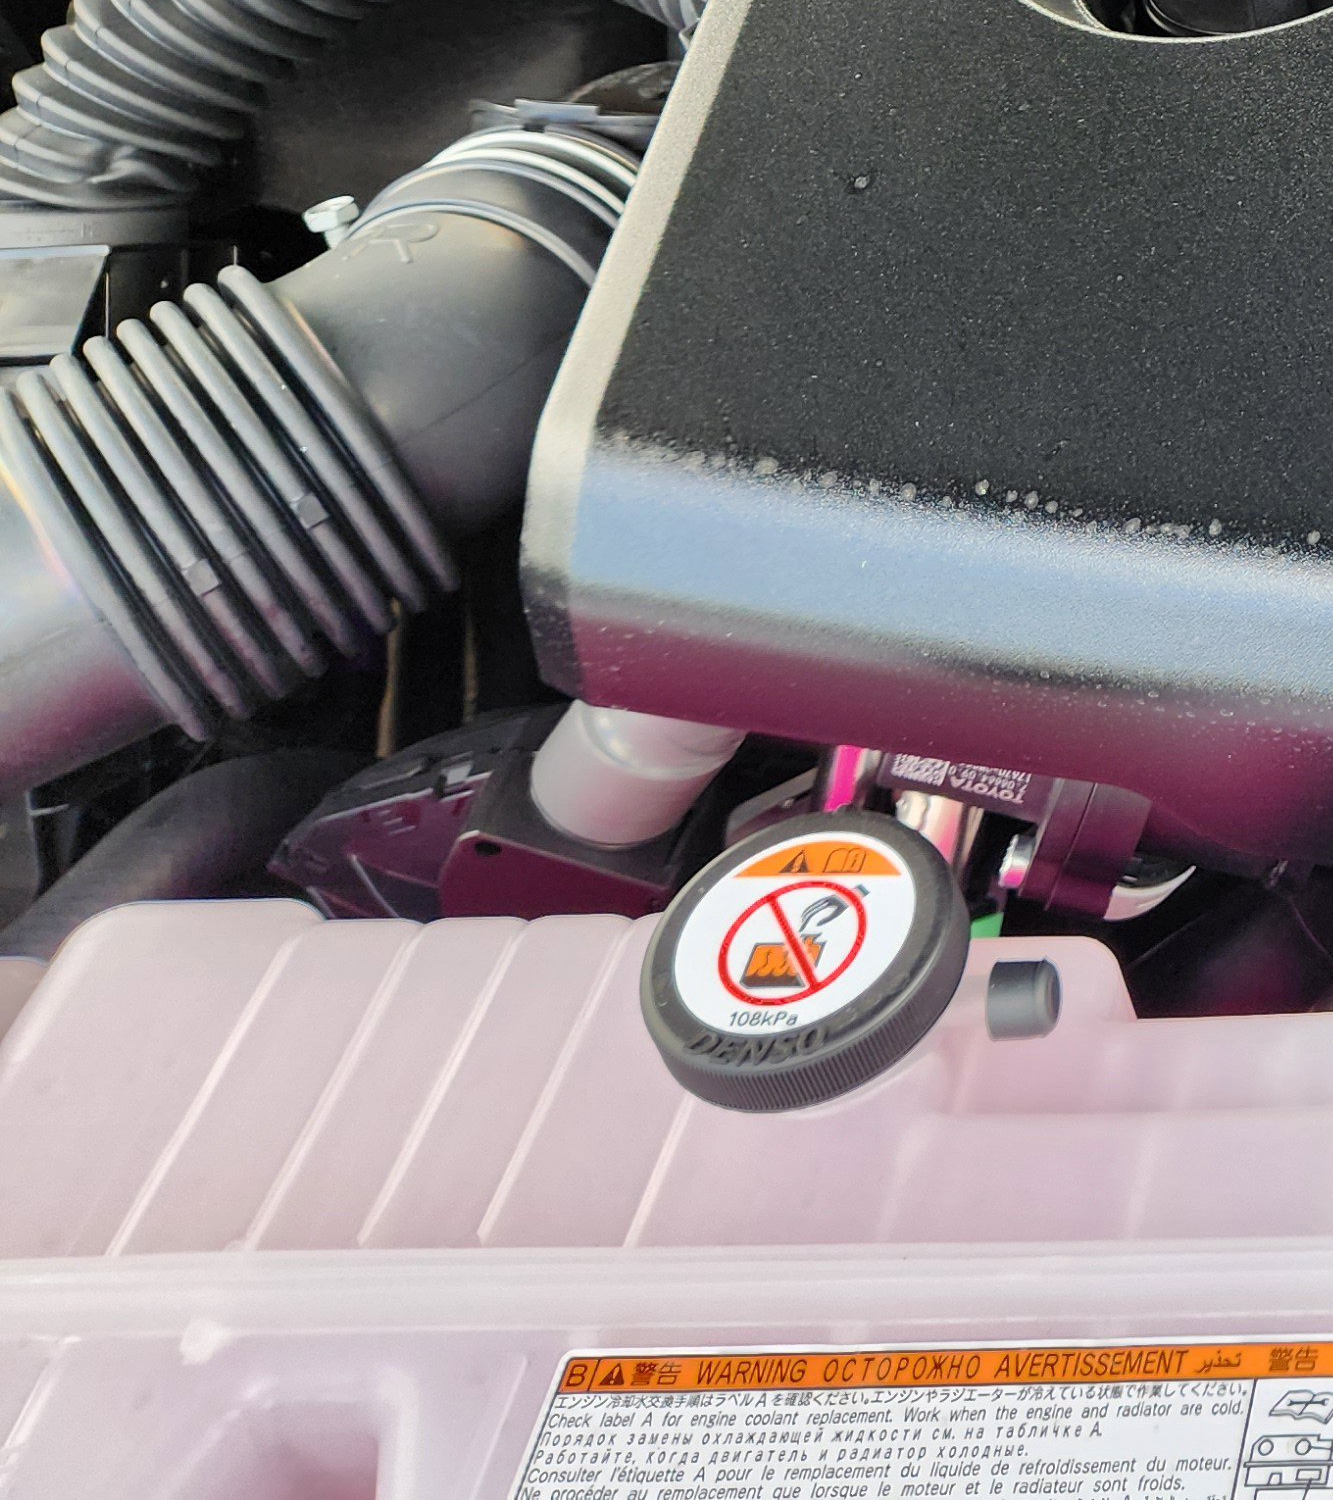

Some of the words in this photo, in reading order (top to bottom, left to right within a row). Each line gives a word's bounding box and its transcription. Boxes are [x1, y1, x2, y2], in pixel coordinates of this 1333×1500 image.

[950, 775, 1024, 804] TOYOTA
[729, 1010, 799, 1027] 108kPa
[684, 1025, 828, 1068] DENSO
[565, 1363, 588, 1387] B
[630, 1361, 681, 1386] 警告
[697, 1358, 808, 1386] WARNING
[993, 1349, 1190, 1378] AVERTISSEMENT
[1269, 1347, 1319, 1372] 警告
[548, 1412, 592, 1429] Check
[600, 1412, 636, 1428] label
[641, 1411, 653, 1427] A
[661, 1411, 684, 1428] for
[690, 1411, 737, 1429] engine
[744, 1410, 799, 1427] coolant
[805, 1408, 893, 1427] replacement.
[903, 1406, 941, 1423] Work
[949, 1406, 987, 1423] when
[995, 1404, 1018, 1421] the
[1025, 1404, 1073, 1422] engine
[1081, 1402, 1110, 1420] and
[1116, 1401, 1173, 1418] radiator
[1180, 1402, 1203, 1417] are
[1211, 1399, 1244, 1415] cold.
[540, 1431, 618, 1448] Порядок
[626, 1432, 694, 1446] замены
[701, 1427, 824, 1446] охлаждающей
[831, 1428, 922, 1444] жидкости
[931, 1428, 956, 1441] см.
[964, 1426, 985, 1440] на
[996, 1422, 1083, 1439] табличке
[533, 1448, 637, 1466] Работайте,
[645, 1450, 701, 1466] когда
[708, 1449, 808, 1466] двигатель
[818, 1449, 829, 1461] и
[836, 1447, 927, 1463] радиатор
[936, 1444, 1029, 1460] холодные.
[527, 1467, 603, 1484] Consulter
[609, 1465, 685, 1485] l'étiquette
[693, 1466, 706, 1482] A
[714, 1468, 754, 1484] pour
[761, 1465, 777, 1481] le
[783, 1463, 893, 1482] remplacement
[900, 1462, 921, 1479] du
[929, 1460, 981, 1480] liquide
[990, 1460, 1011, 1476] de
[1018, 1458, 1137, 1476] refroidissement
[1146, 1456, 1167, 1472] du
[1175, 1456, 1233, 1472] moteur.
[519, 1487, 541, 1500] Ne
[626, 1488, 649, 1500] au
[656, 1485, 764, 1500] remplacement
[772, 1486, 803, 1500] que
[810, 1483, 869, 1500] lorsque
[877, 1481, 892, 1497] le
[900, 1483, 957, 1499] moteur
[965, 1480, 981, 1496] et
[989, 1479, 1004, 1495] le
[1012, 1478, 1085, 1494] radiateur
[1092, 1477, 1129, 1493] sont
[1138, 1474, 1187, 1492] froids.
